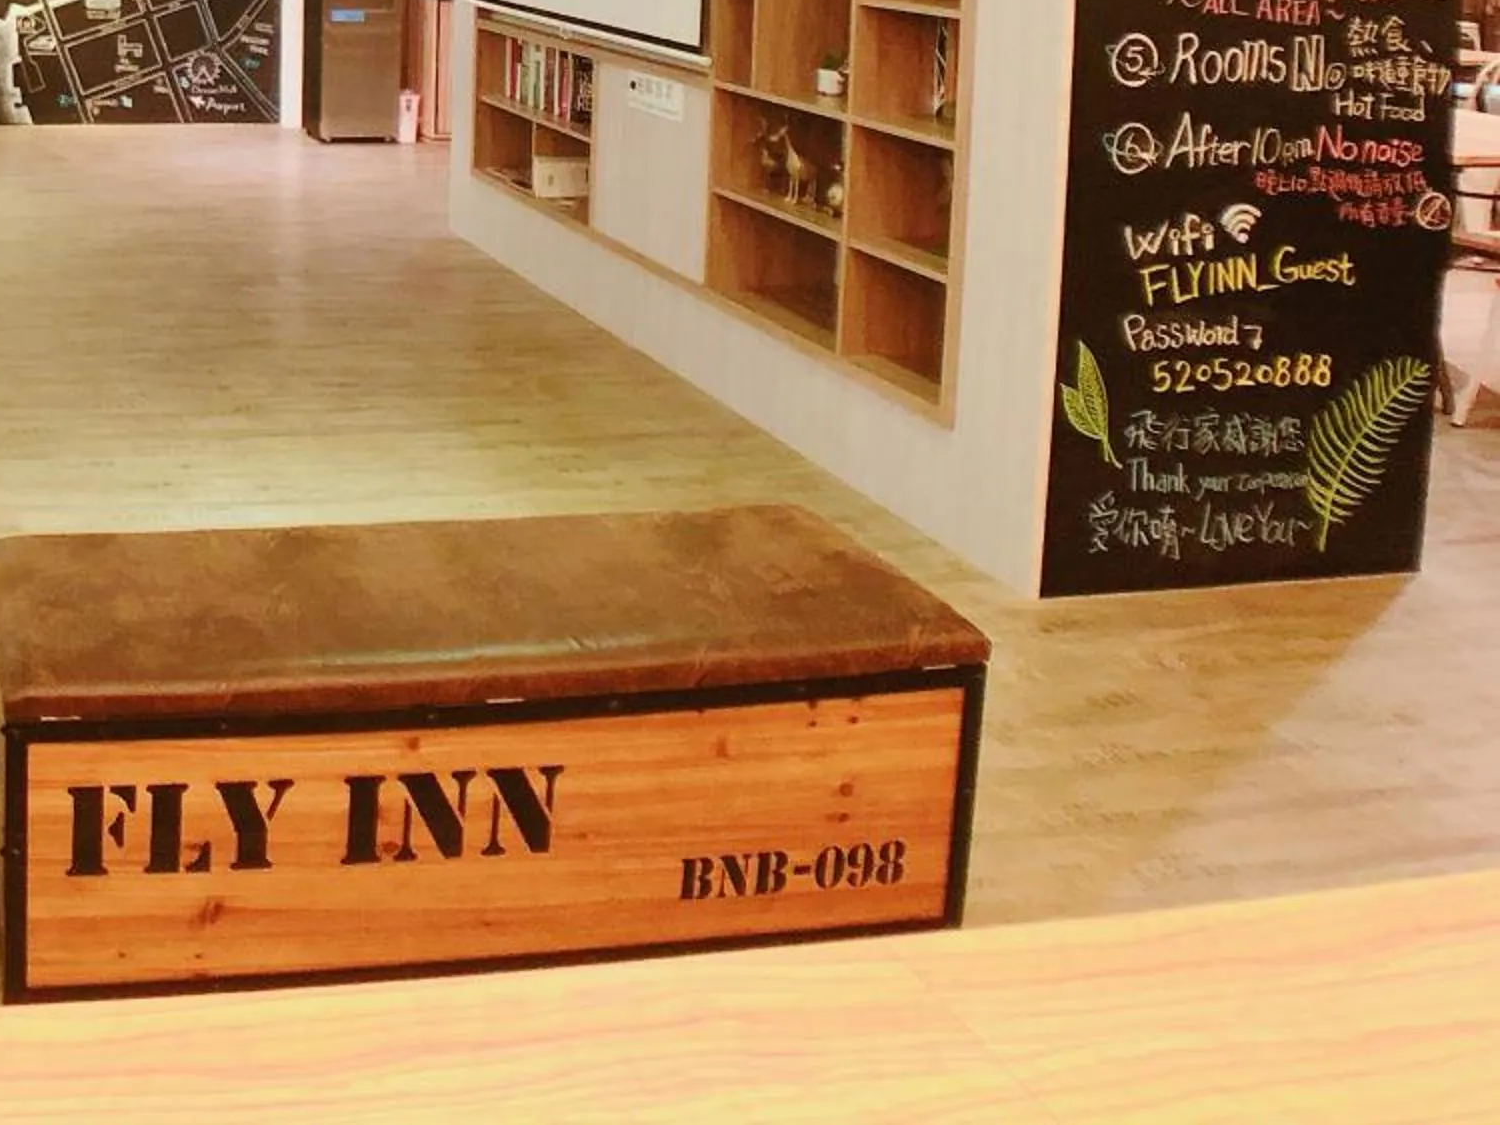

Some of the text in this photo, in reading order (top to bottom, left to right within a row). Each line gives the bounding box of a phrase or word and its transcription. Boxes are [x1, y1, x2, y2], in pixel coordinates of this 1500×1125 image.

[1169, 32, 1287, 86] Rooms
[1290, 33, 1346, 92] No
[1334, 88, 1426, 122] Hot Food
[1164, 112, 1252, 169] After
[1315, 124, 1355, 166] No
[1360, 138, 1426, 167] noise
[1151, 354, 1332, 393] 520520888
[1126, 457, 1191, 493] Thank
[66, 765, 563, 877] FLY INN
[680, 840, 907, 901] BNB-098
